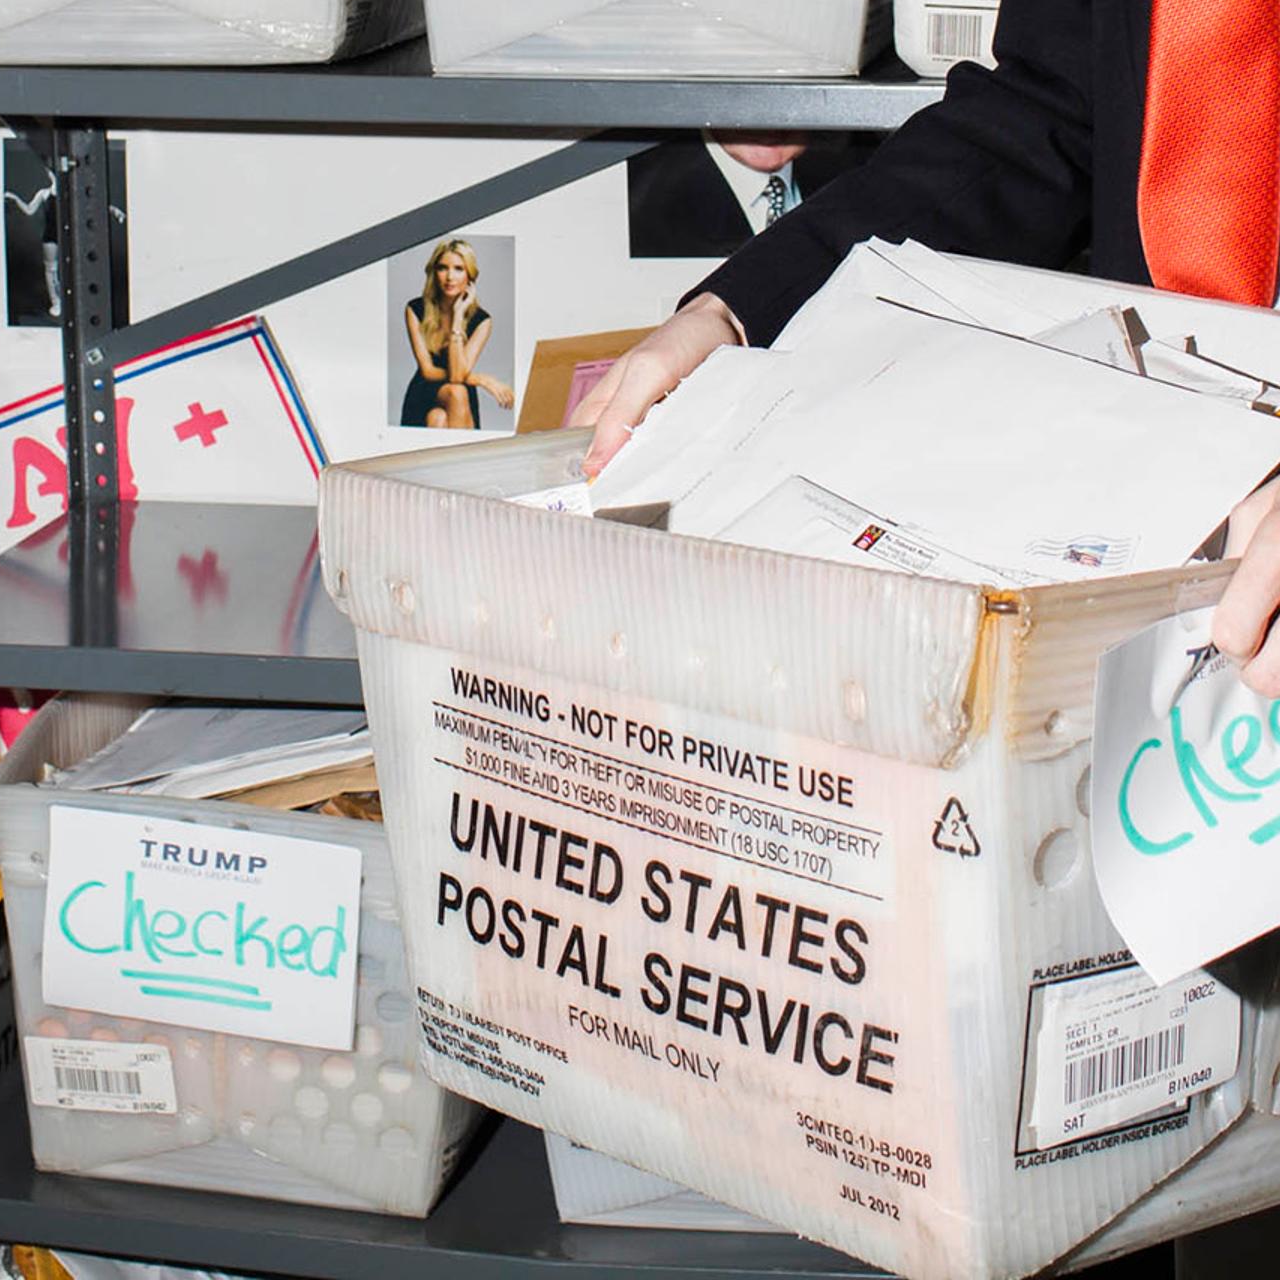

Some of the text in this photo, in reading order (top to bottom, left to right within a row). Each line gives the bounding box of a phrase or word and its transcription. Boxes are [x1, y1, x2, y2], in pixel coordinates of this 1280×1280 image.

[450, 667, 854, 808] WARNING NOT FOR PRIVATE USE
[434, 710, 491, 743] MAXIMUM
[549, 750, 577, 773] FOR
[580, 755, 621, 787] THEFT
[624, 770, 647, 794] OR
[648, 775, 705, 812] MISUSE
[706, 794, 726, 817] OF
[729, 797, 790, 836] POSTAL
[791, 820, 881, 859] PROPERTY
[503, 760, 531, 785] FINE
[561, 778, 571, 797] 3
[572, 782, 616, 813] YEARS
[619, 794, 729, 848] IMPRISONMENT
[731, 830, 754, 858] (18
[756, 837, 789, 865] USC
[793, 847, 833, 880] 1707)
[139, 838, 268, 874] TRUMP
[449, 792, 869, 986] UNITED STATES
[59, 870, 347, 979] Checked
[437, 872, 622, 999] POSTAL
[640, 952, 900, 1094] SERVICE
[1184, 981, 1216, 1004] 10022
[567, 1006, 721, 1084] FOR MAIL ONLY
[1168, 1067, 1213, 1095] BIN040
[806, 1134, 839, 1159] PSIN
[1015, 1116, 1189, 1170] PLACE LABEL HOLDER INSIDE BORDER
[1063, 1114, 1087, 1133] SAT
[839, 1184, 900, 1221] JUL 2012
